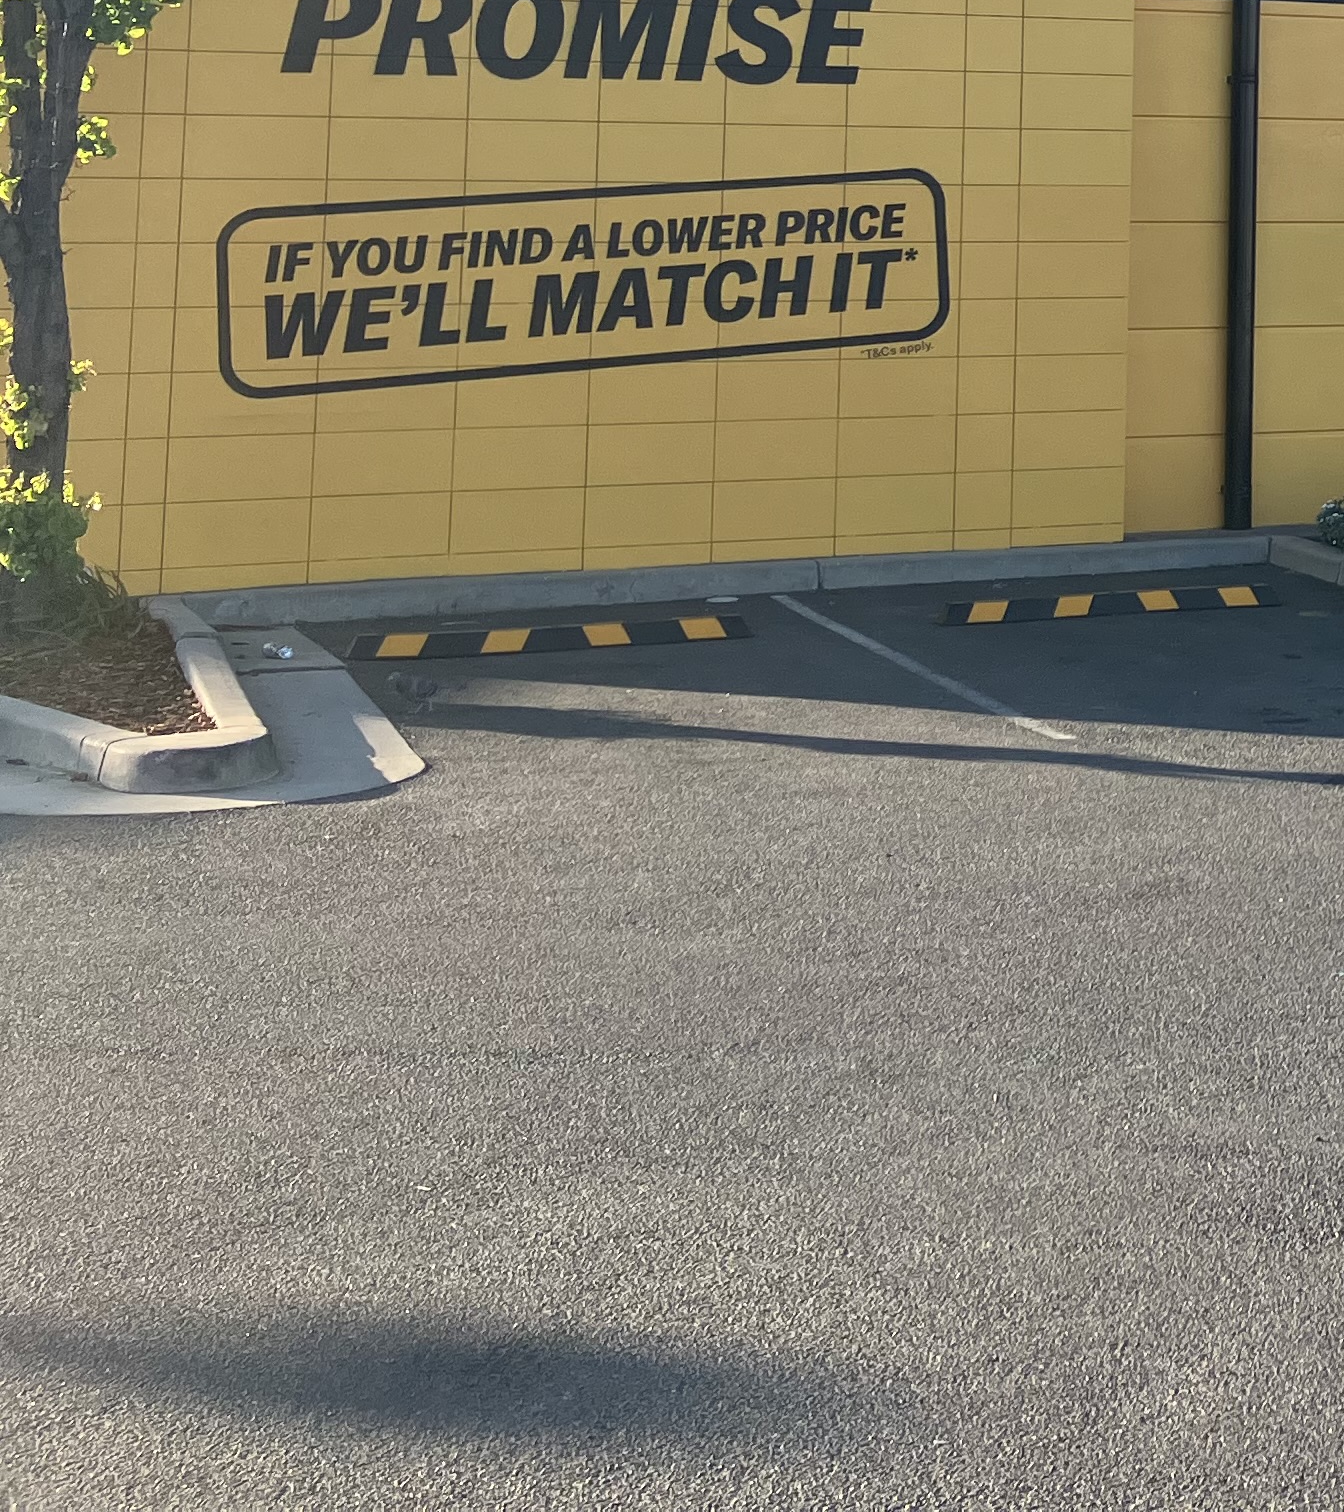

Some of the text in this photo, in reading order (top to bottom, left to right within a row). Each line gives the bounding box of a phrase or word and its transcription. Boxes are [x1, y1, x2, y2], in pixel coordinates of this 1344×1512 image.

[264, 203, 906, 283] IF YOU FIND A LOWER PRICE
[264, 278, 507, 360] WE’LL
[528, 255, 814, 337] MATCH
